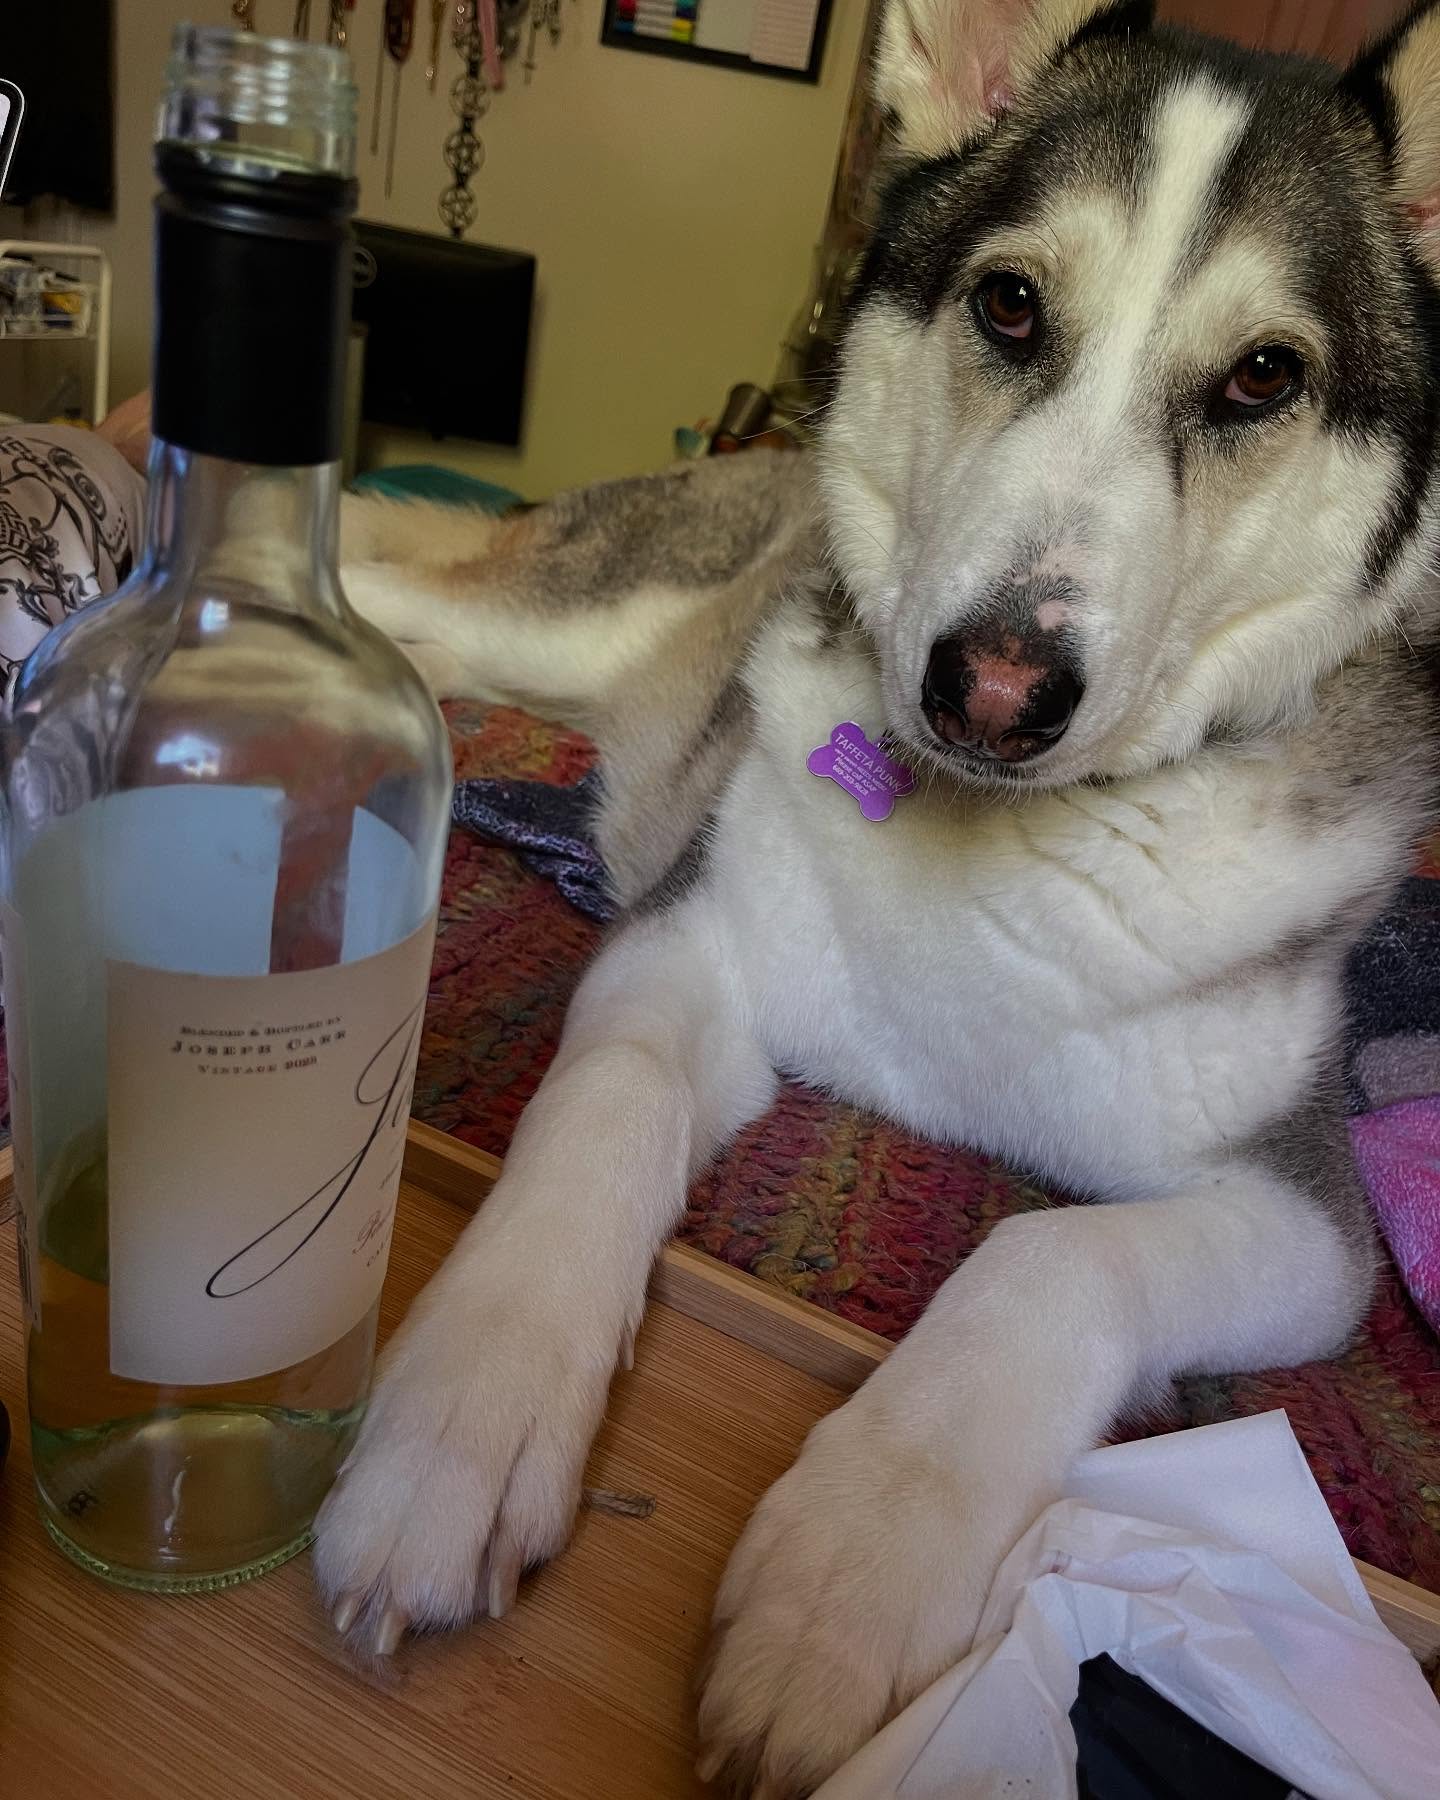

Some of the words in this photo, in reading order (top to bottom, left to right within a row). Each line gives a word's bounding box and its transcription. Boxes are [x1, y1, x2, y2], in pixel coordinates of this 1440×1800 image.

[835, 732, 875, 770] TAFFETA
[872, 765, 903, 791] PUNK
[249, 1028, 260, 1037] &
[171, 1040, 272, 1056] JOSEPH
[285, 1030, 347, 1052] CARR
[197, 1063, 278, 1075] VINTAGE
